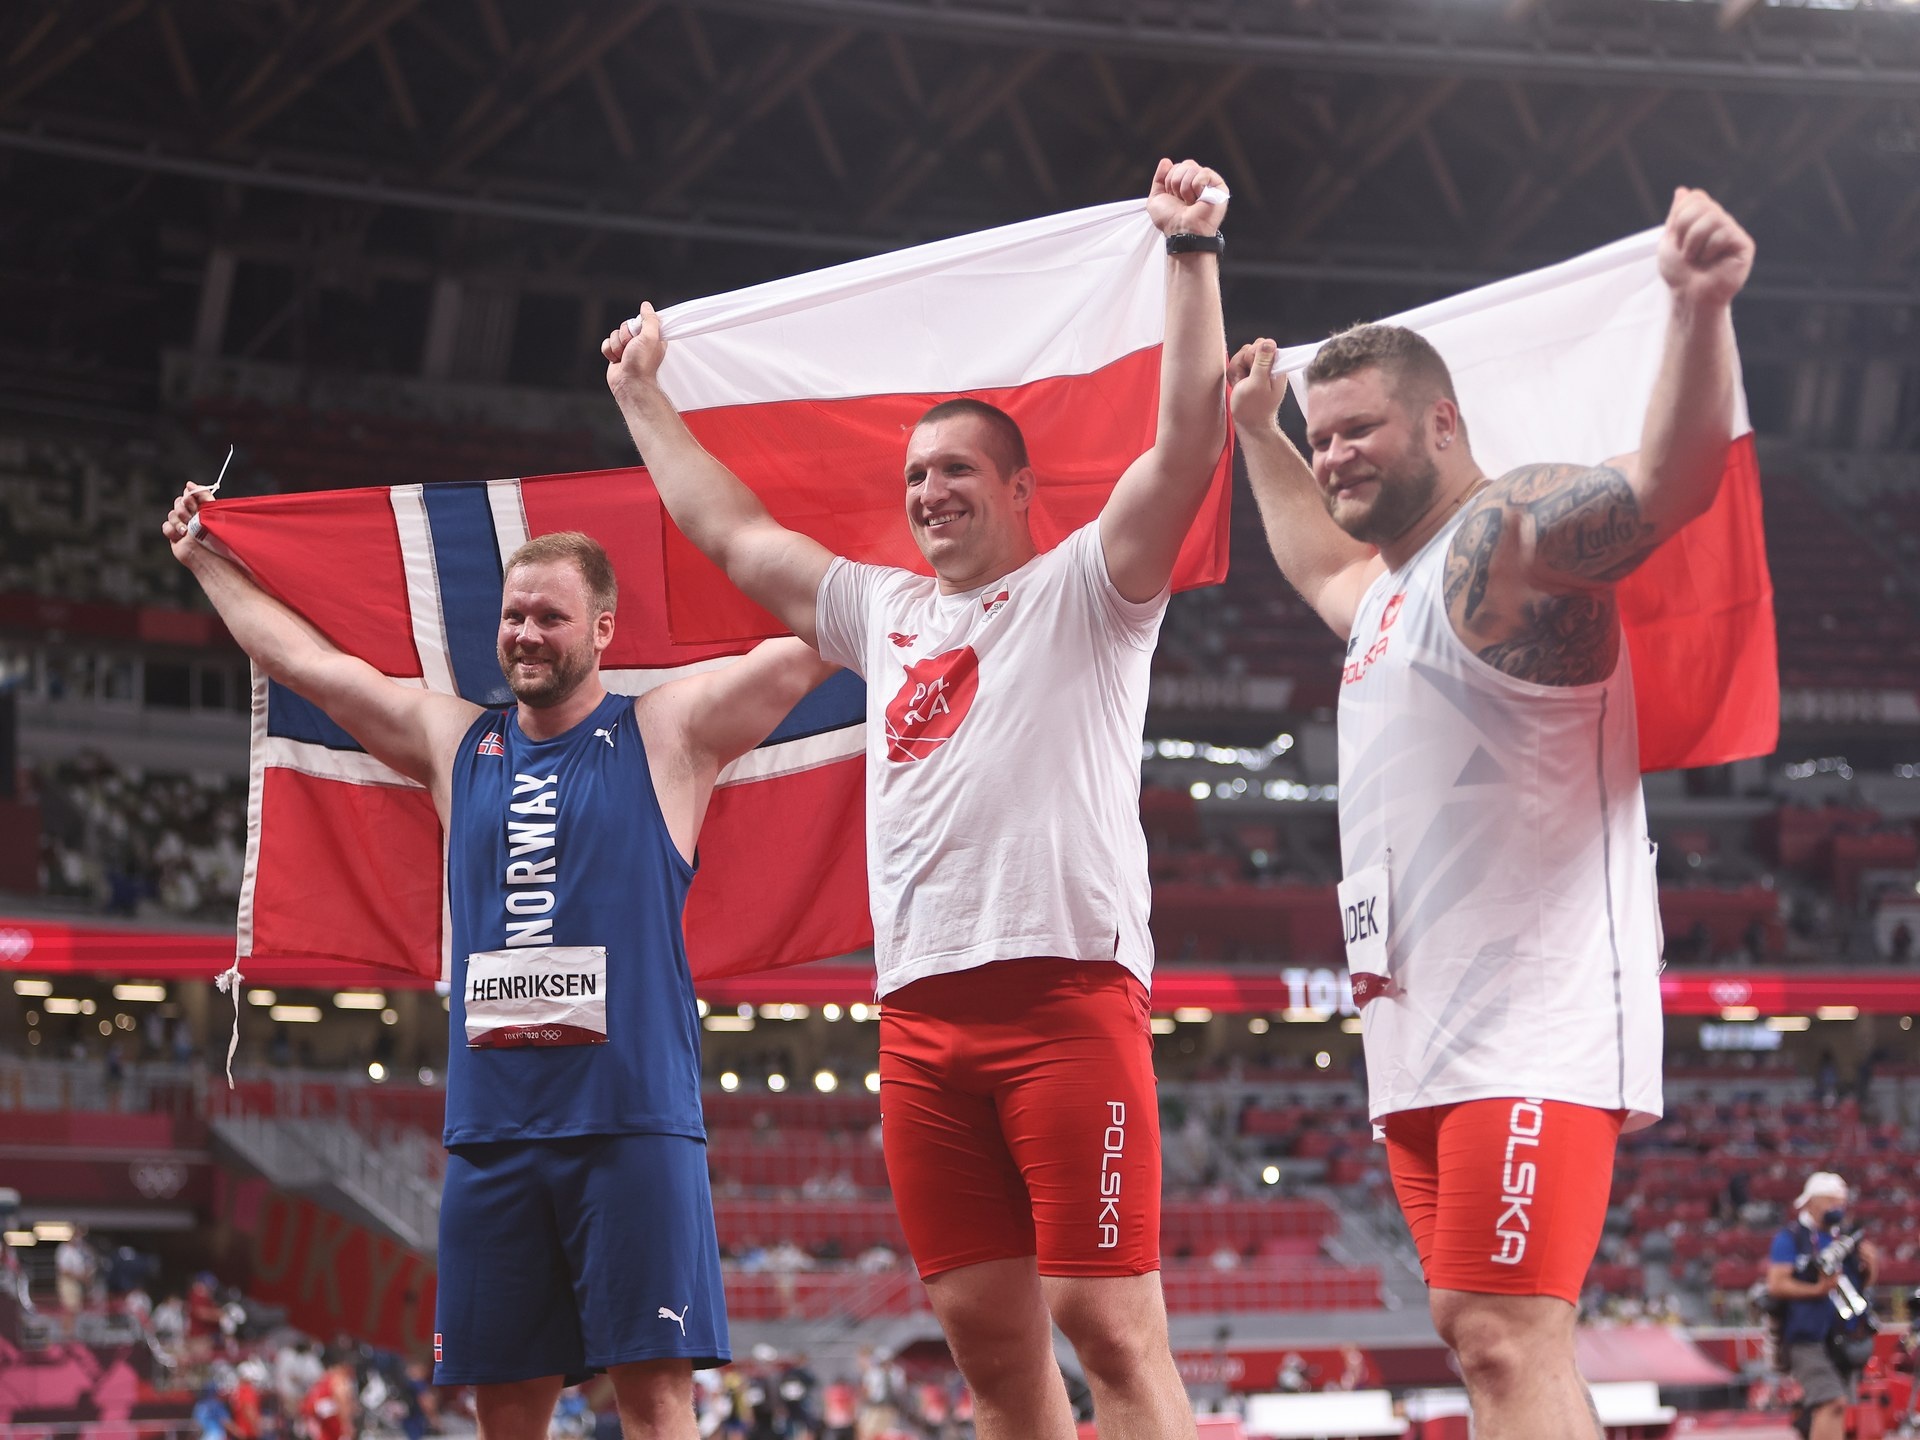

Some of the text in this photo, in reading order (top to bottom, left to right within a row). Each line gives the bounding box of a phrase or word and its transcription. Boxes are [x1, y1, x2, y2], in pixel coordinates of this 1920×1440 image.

[1343, 636, 1388, 684] POLKA
[505, 774, 558, 947] NORWAY
[473, 974, 596, 1002] HENRIKSEN
[1098, 1101, 1126, 1248] POLSKA
[1490, 1097, 1544, 1265] OLSKA
